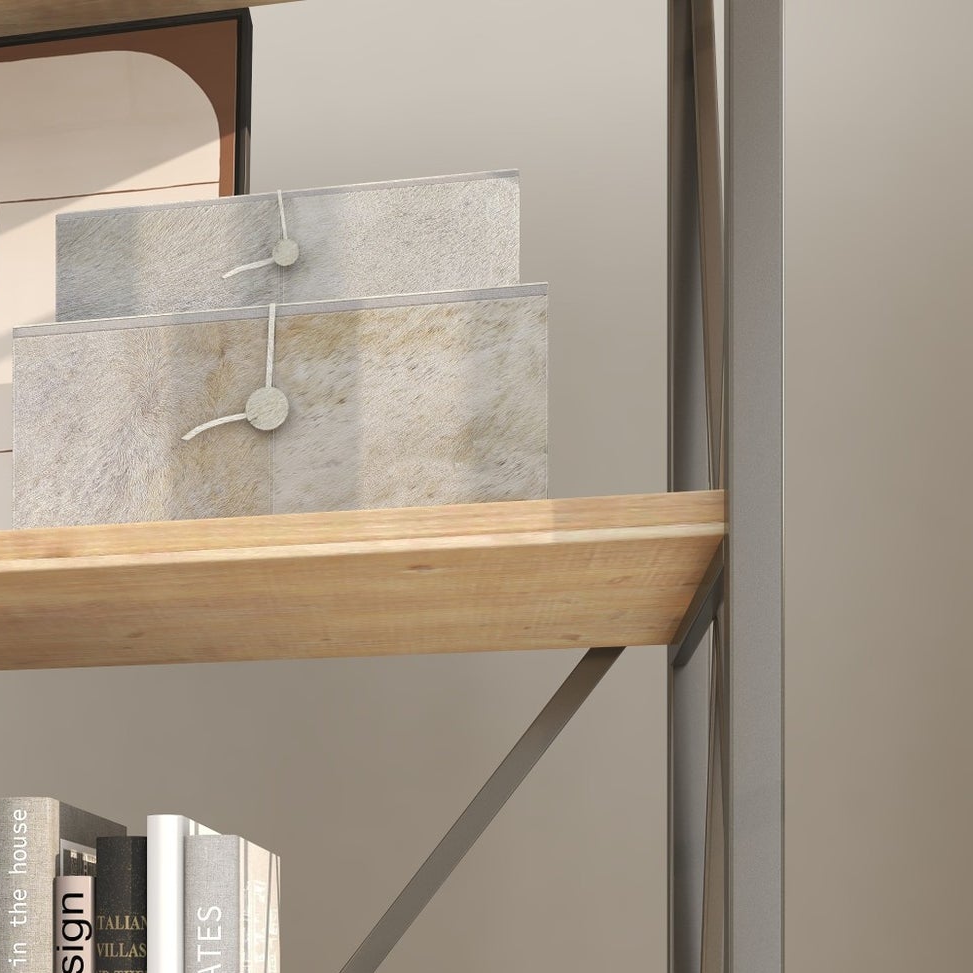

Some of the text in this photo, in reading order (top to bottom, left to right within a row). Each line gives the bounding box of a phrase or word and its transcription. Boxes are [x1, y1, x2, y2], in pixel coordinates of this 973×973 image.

[8, 808, 28, 875] house
[8, 889, 28, 928] the
[96, 915, 147, 931] TALIAN
[8, 942, 28, 967] in
[96, 942, 147, 958] VILLAS
